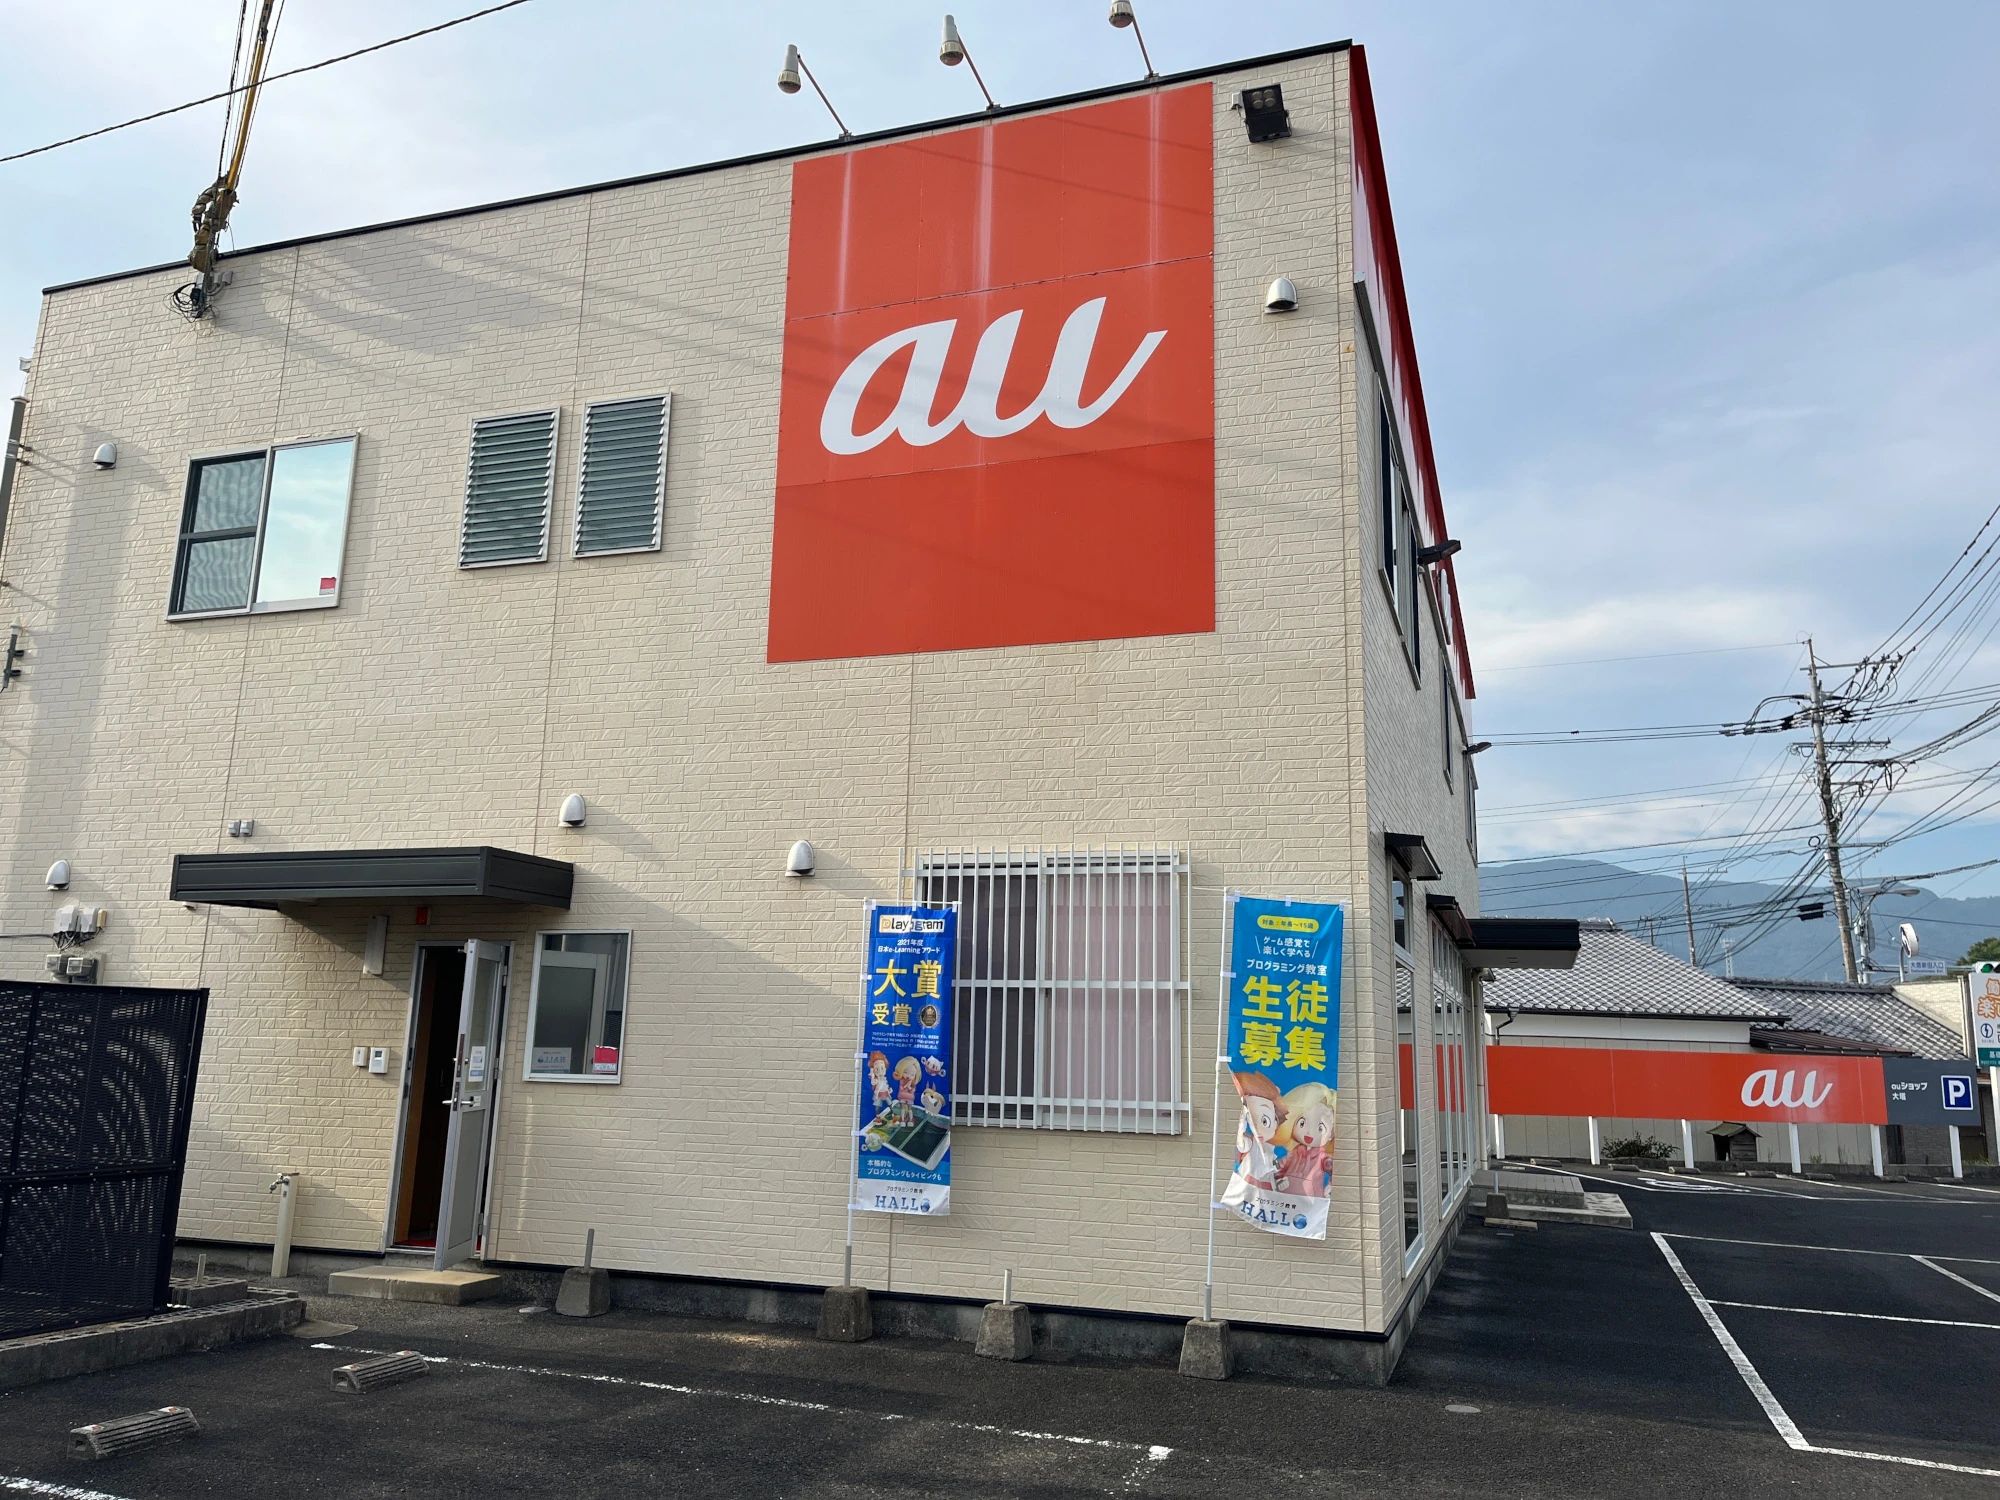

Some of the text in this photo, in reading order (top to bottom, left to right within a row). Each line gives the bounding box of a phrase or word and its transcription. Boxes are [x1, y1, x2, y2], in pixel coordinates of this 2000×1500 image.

[820, 296, 1168, 455] au
[1263, 936, 1311, 948] ゲーム感覚で
[1263, 945, 1311, 958] 楽しく学べる
[873, 959, 942, 999] 大賞
[1247, 959, 1328, 976] プログラミング教室
[1242, 975, 1329, 1025] 生徒
[871, 1002, 912, 1027] 受賞
[1239, 1021, 1326, 1071] 募集
[1741, 1069, 1834, 1109] au
[1891, 1082, 1928, 1091] auショップ
[1948, 1080, 1966, 1106] P
